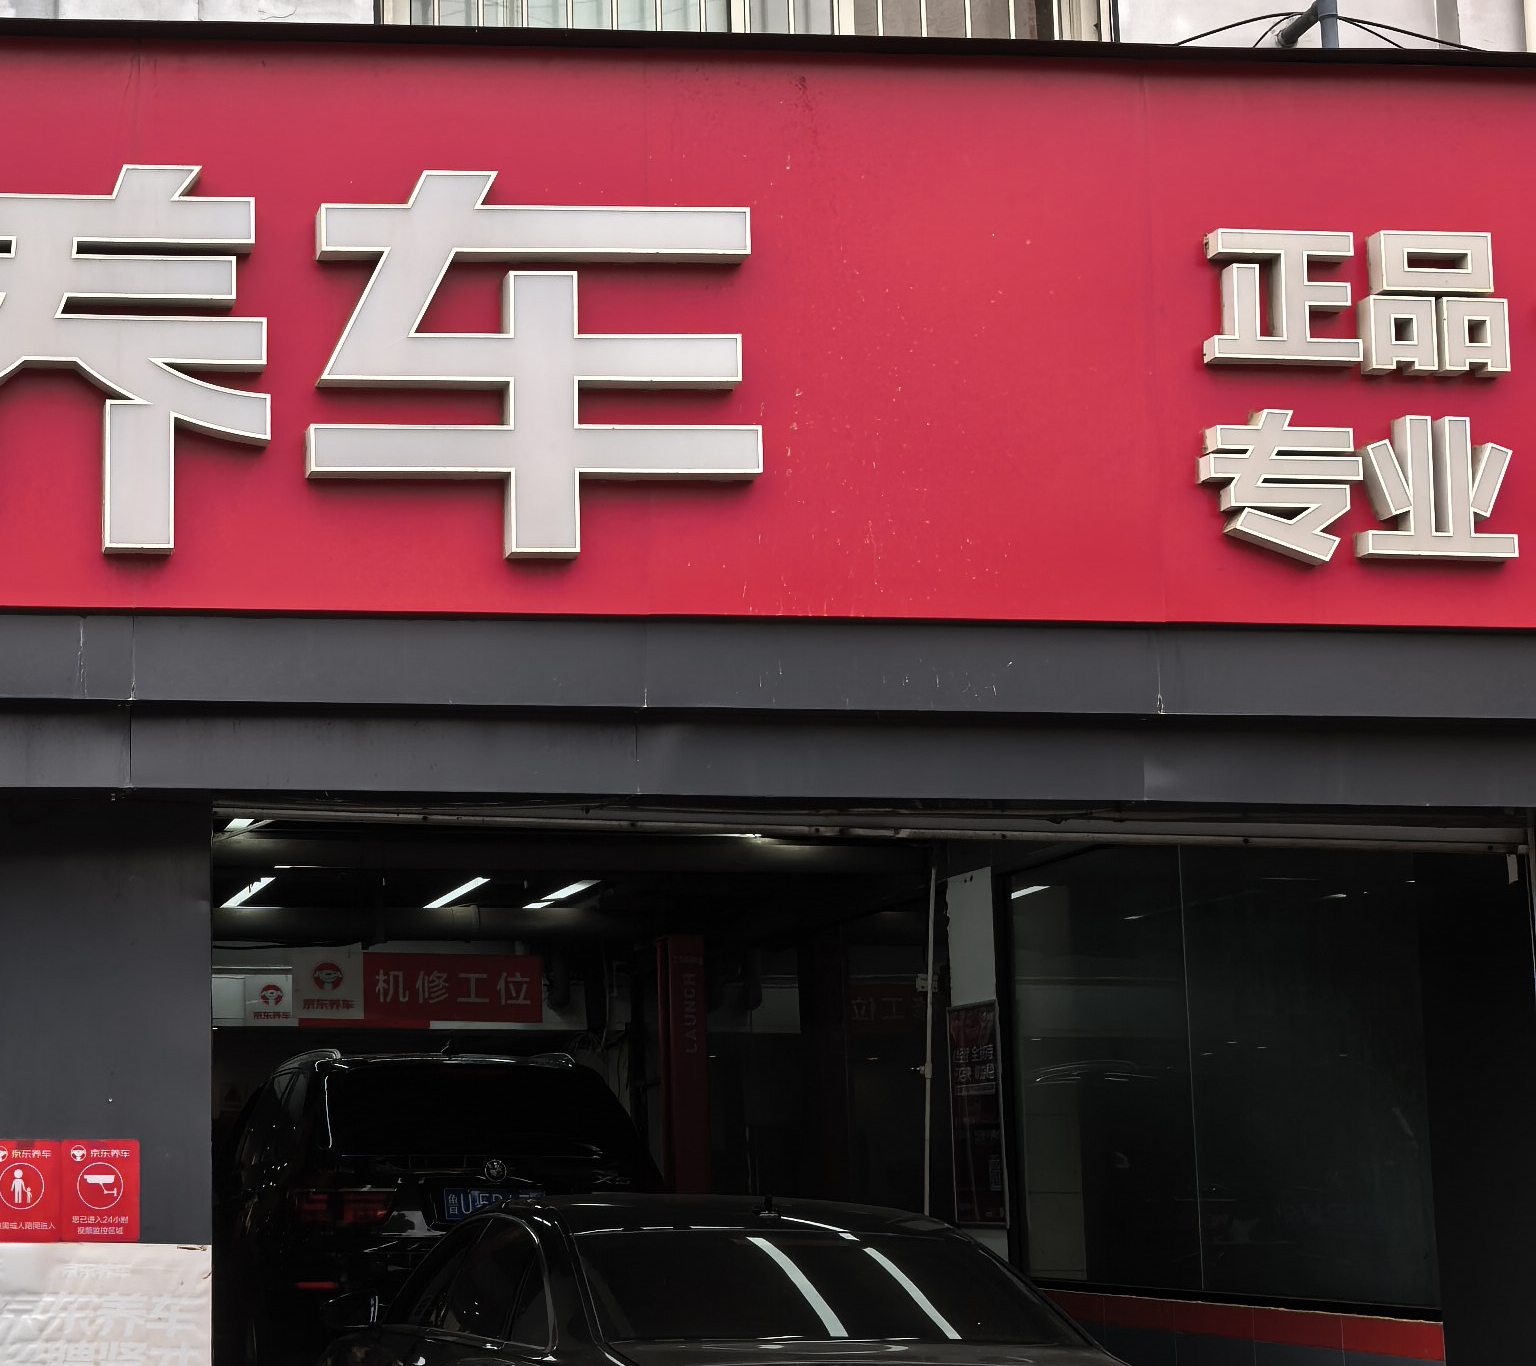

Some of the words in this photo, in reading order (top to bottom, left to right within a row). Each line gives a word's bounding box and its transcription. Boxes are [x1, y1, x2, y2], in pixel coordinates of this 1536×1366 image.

[1204, 228, 1511, 377] 正品
[1196, 409, 1520, 566] 专业
[375, 967, 532, 1006] 机修工位
[682, 972, 698, 1054] LAUNCH
[11, 1148, 52, 1159] 京东养车
[90, 1148, 131, 1158] 京东养车
